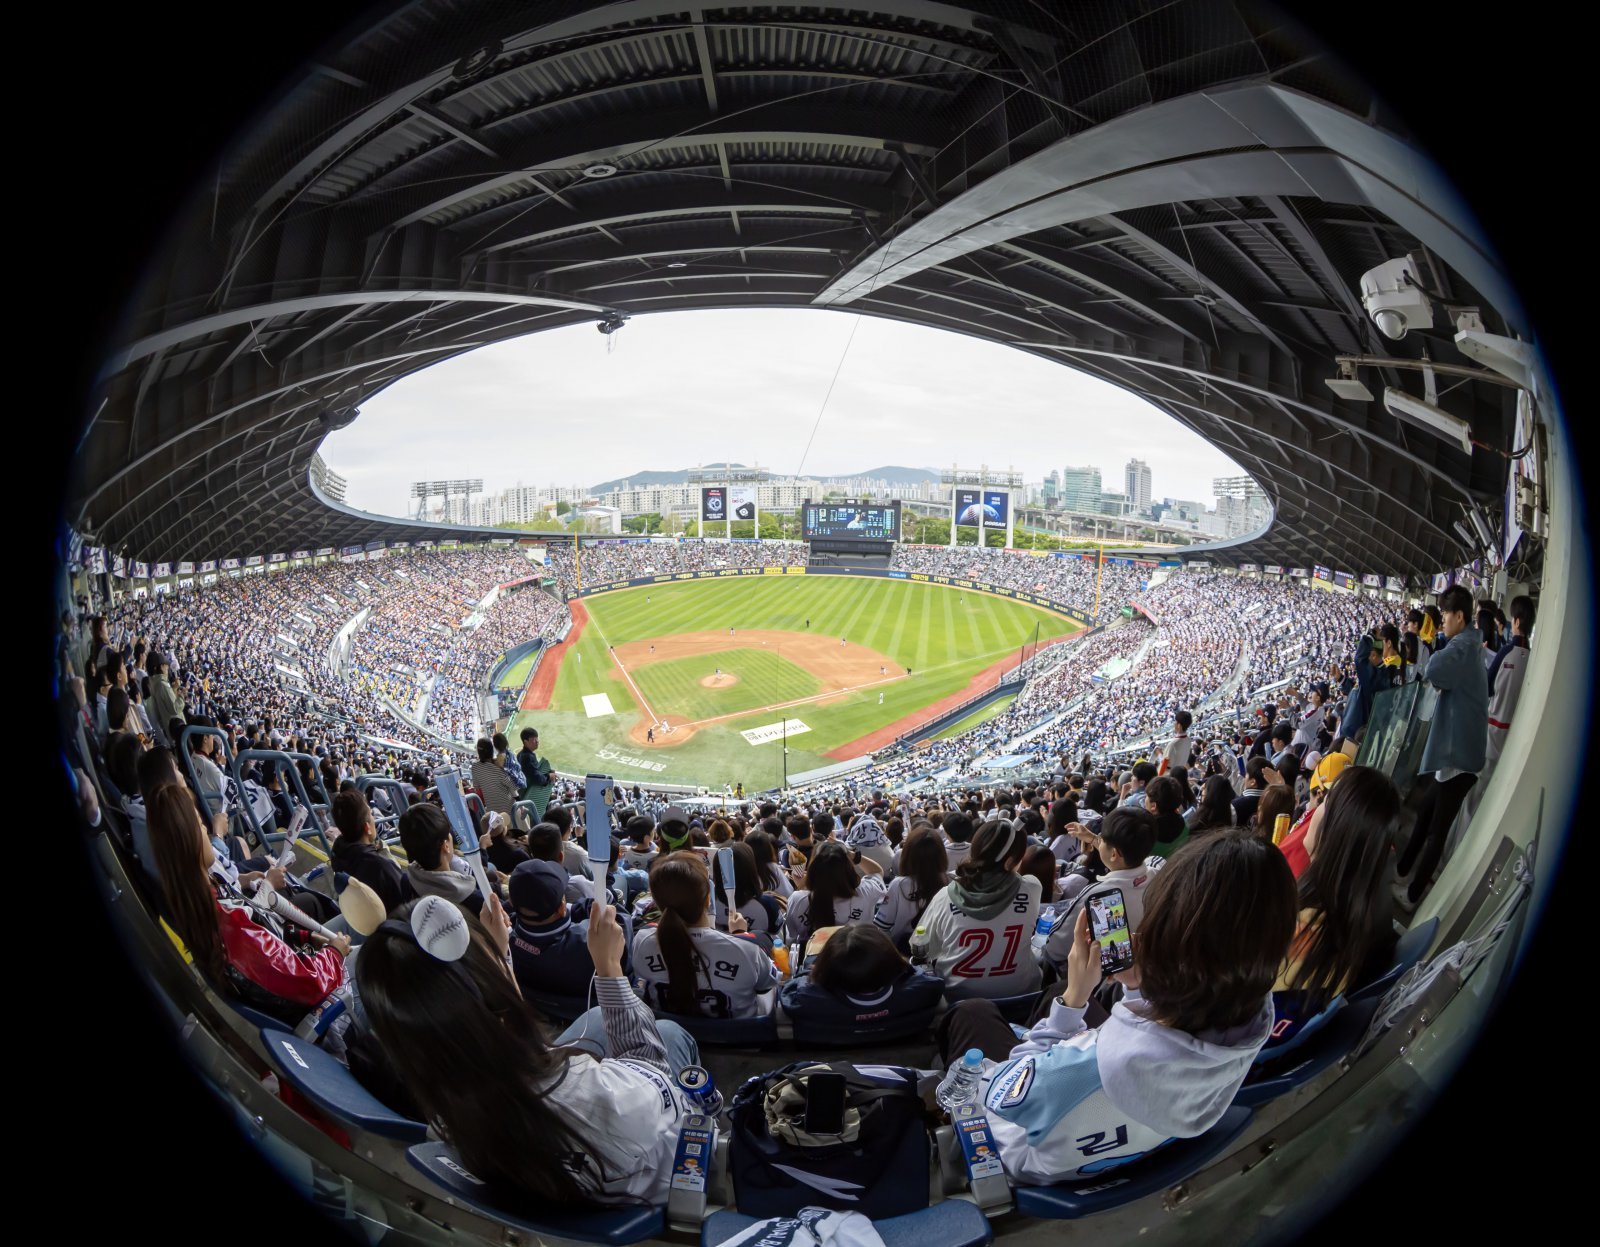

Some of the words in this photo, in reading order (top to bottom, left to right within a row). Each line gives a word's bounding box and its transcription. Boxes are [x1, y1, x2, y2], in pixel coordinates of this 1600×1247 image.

[949, 892, 1030, 917] 박웅
[951, 924, 1024, 978] 21
[645, 954, 739, 981] 김연
